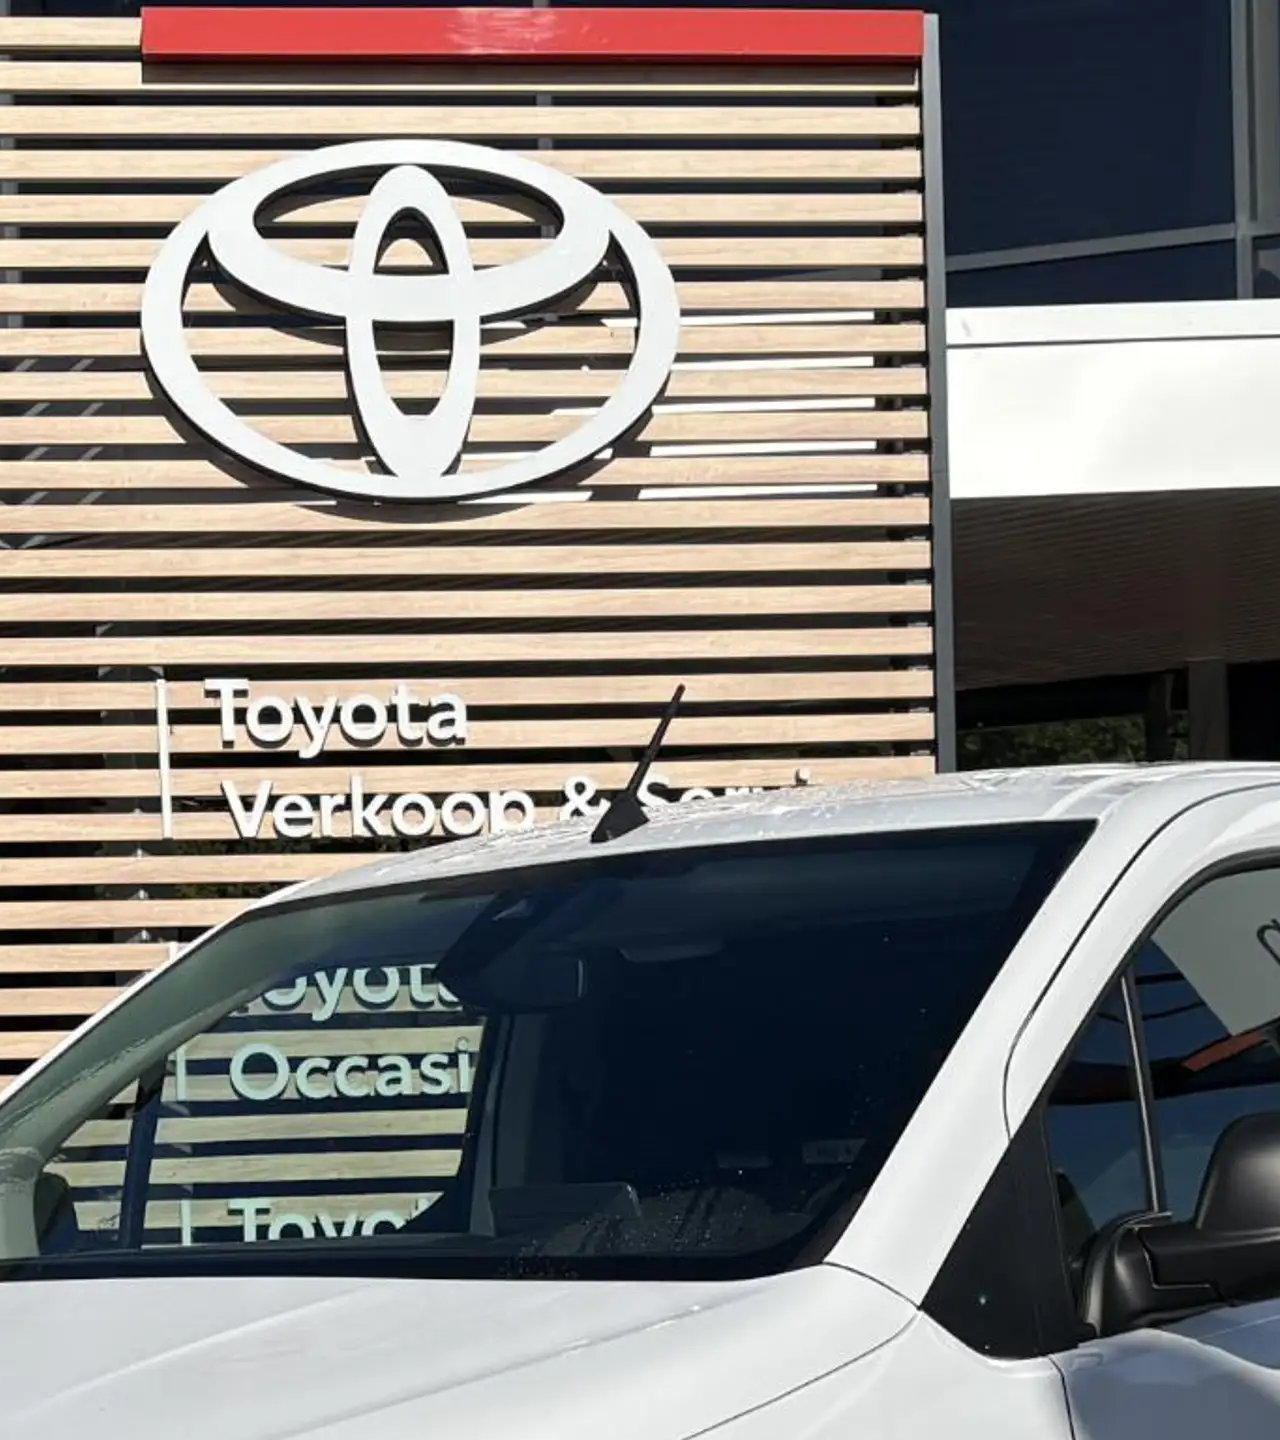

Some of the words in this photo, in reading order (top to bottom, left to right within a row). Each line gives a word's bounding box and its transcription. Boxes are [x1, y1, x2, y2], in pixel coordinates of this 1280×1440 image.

[204, 678, 468, 760] Toyota
[222, 778, 535, 840] Verkoop
[238, 964, 463, 1022] oyot
[228, 1036, 471, 1101] Occasi
[228, 1197, 428, 1244] Too
